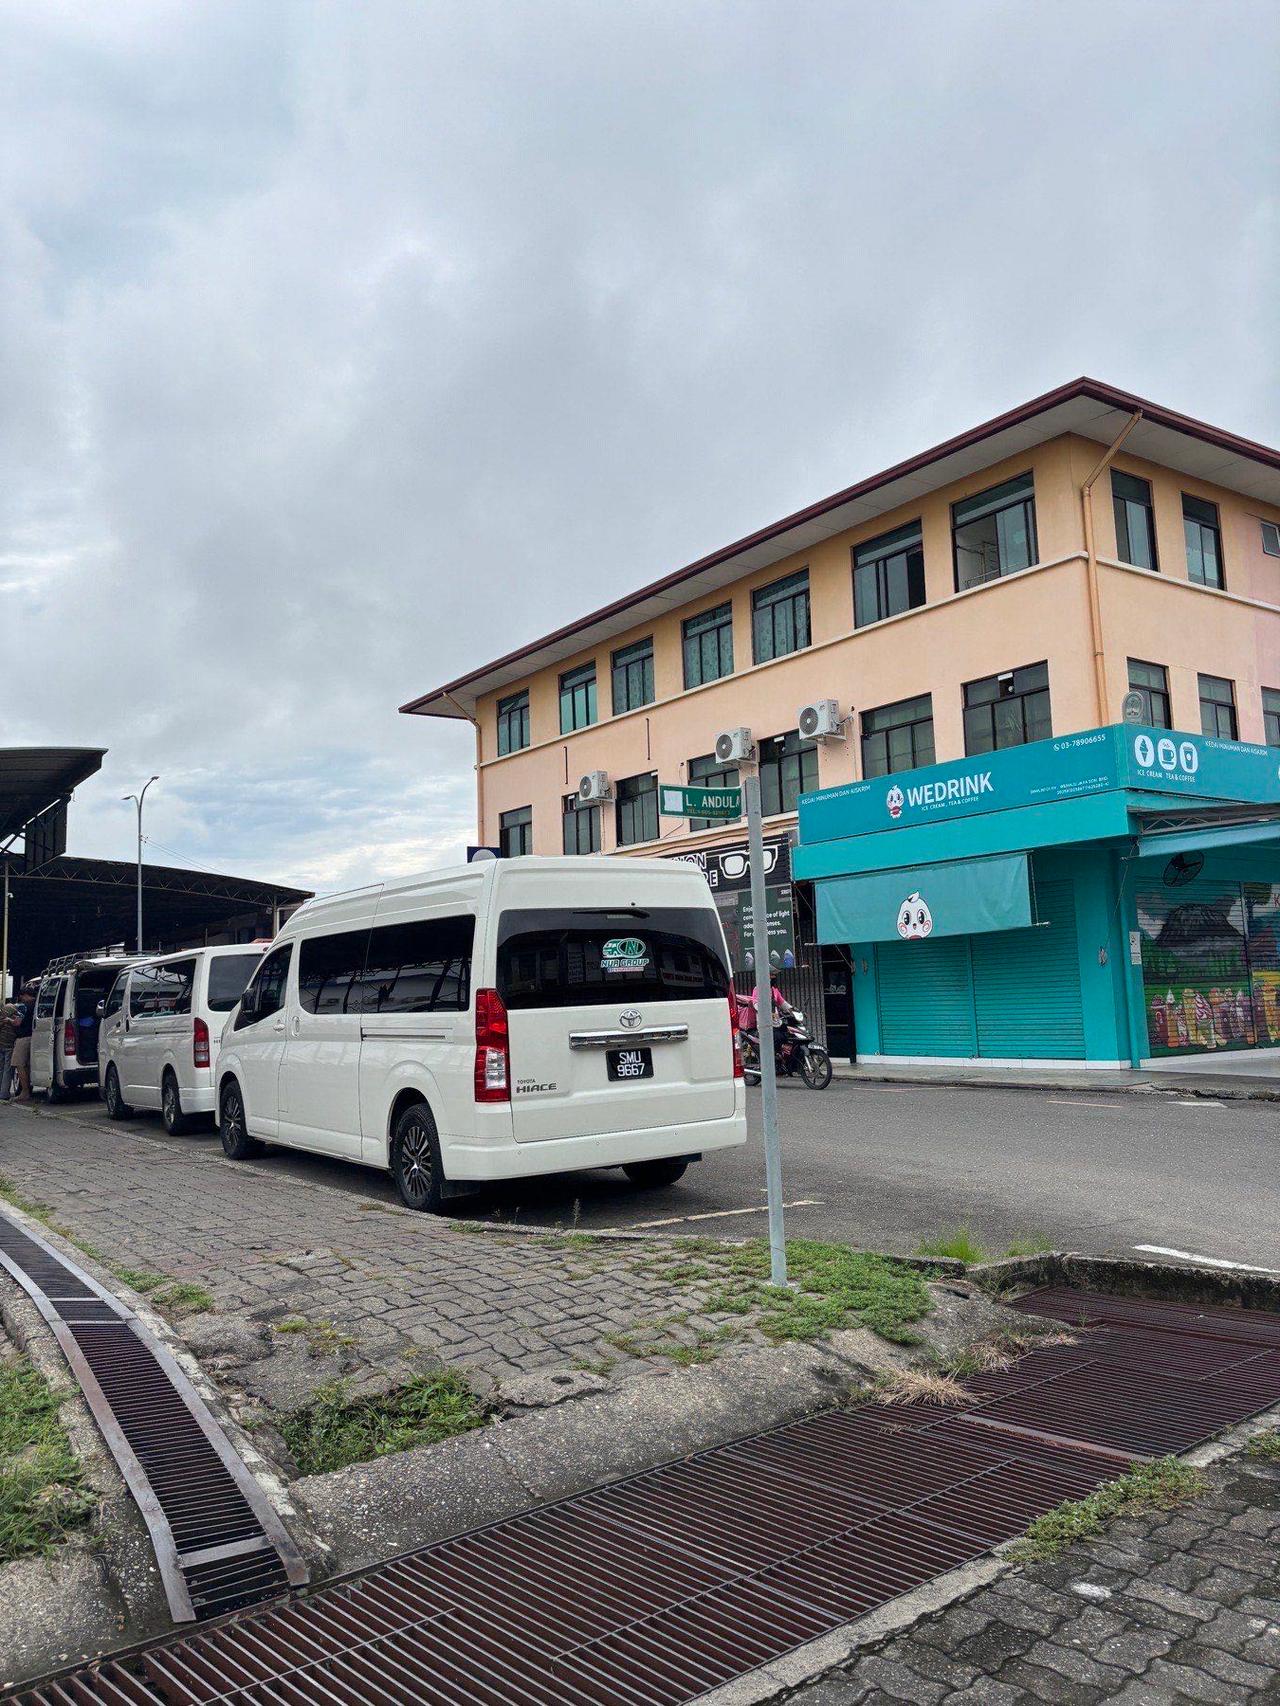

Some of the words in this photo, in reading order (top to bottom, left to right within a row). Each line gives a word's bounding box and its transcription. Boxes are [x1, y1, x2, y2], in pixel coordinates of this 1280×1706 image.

[1060, 734, 1106, 750] 03-78906655
[1146, 770, 1162, 778] CREAM
[906, 772, 994, 808] WEDRINK
[685, 794, 697, 807] L.
[620, 958, 649, 967] GROUP
[619, 1051, 642, 1064] SMU
[617, 1063, 645, 1077] 9667
[516, 1082, 557, 1094] HIACE
